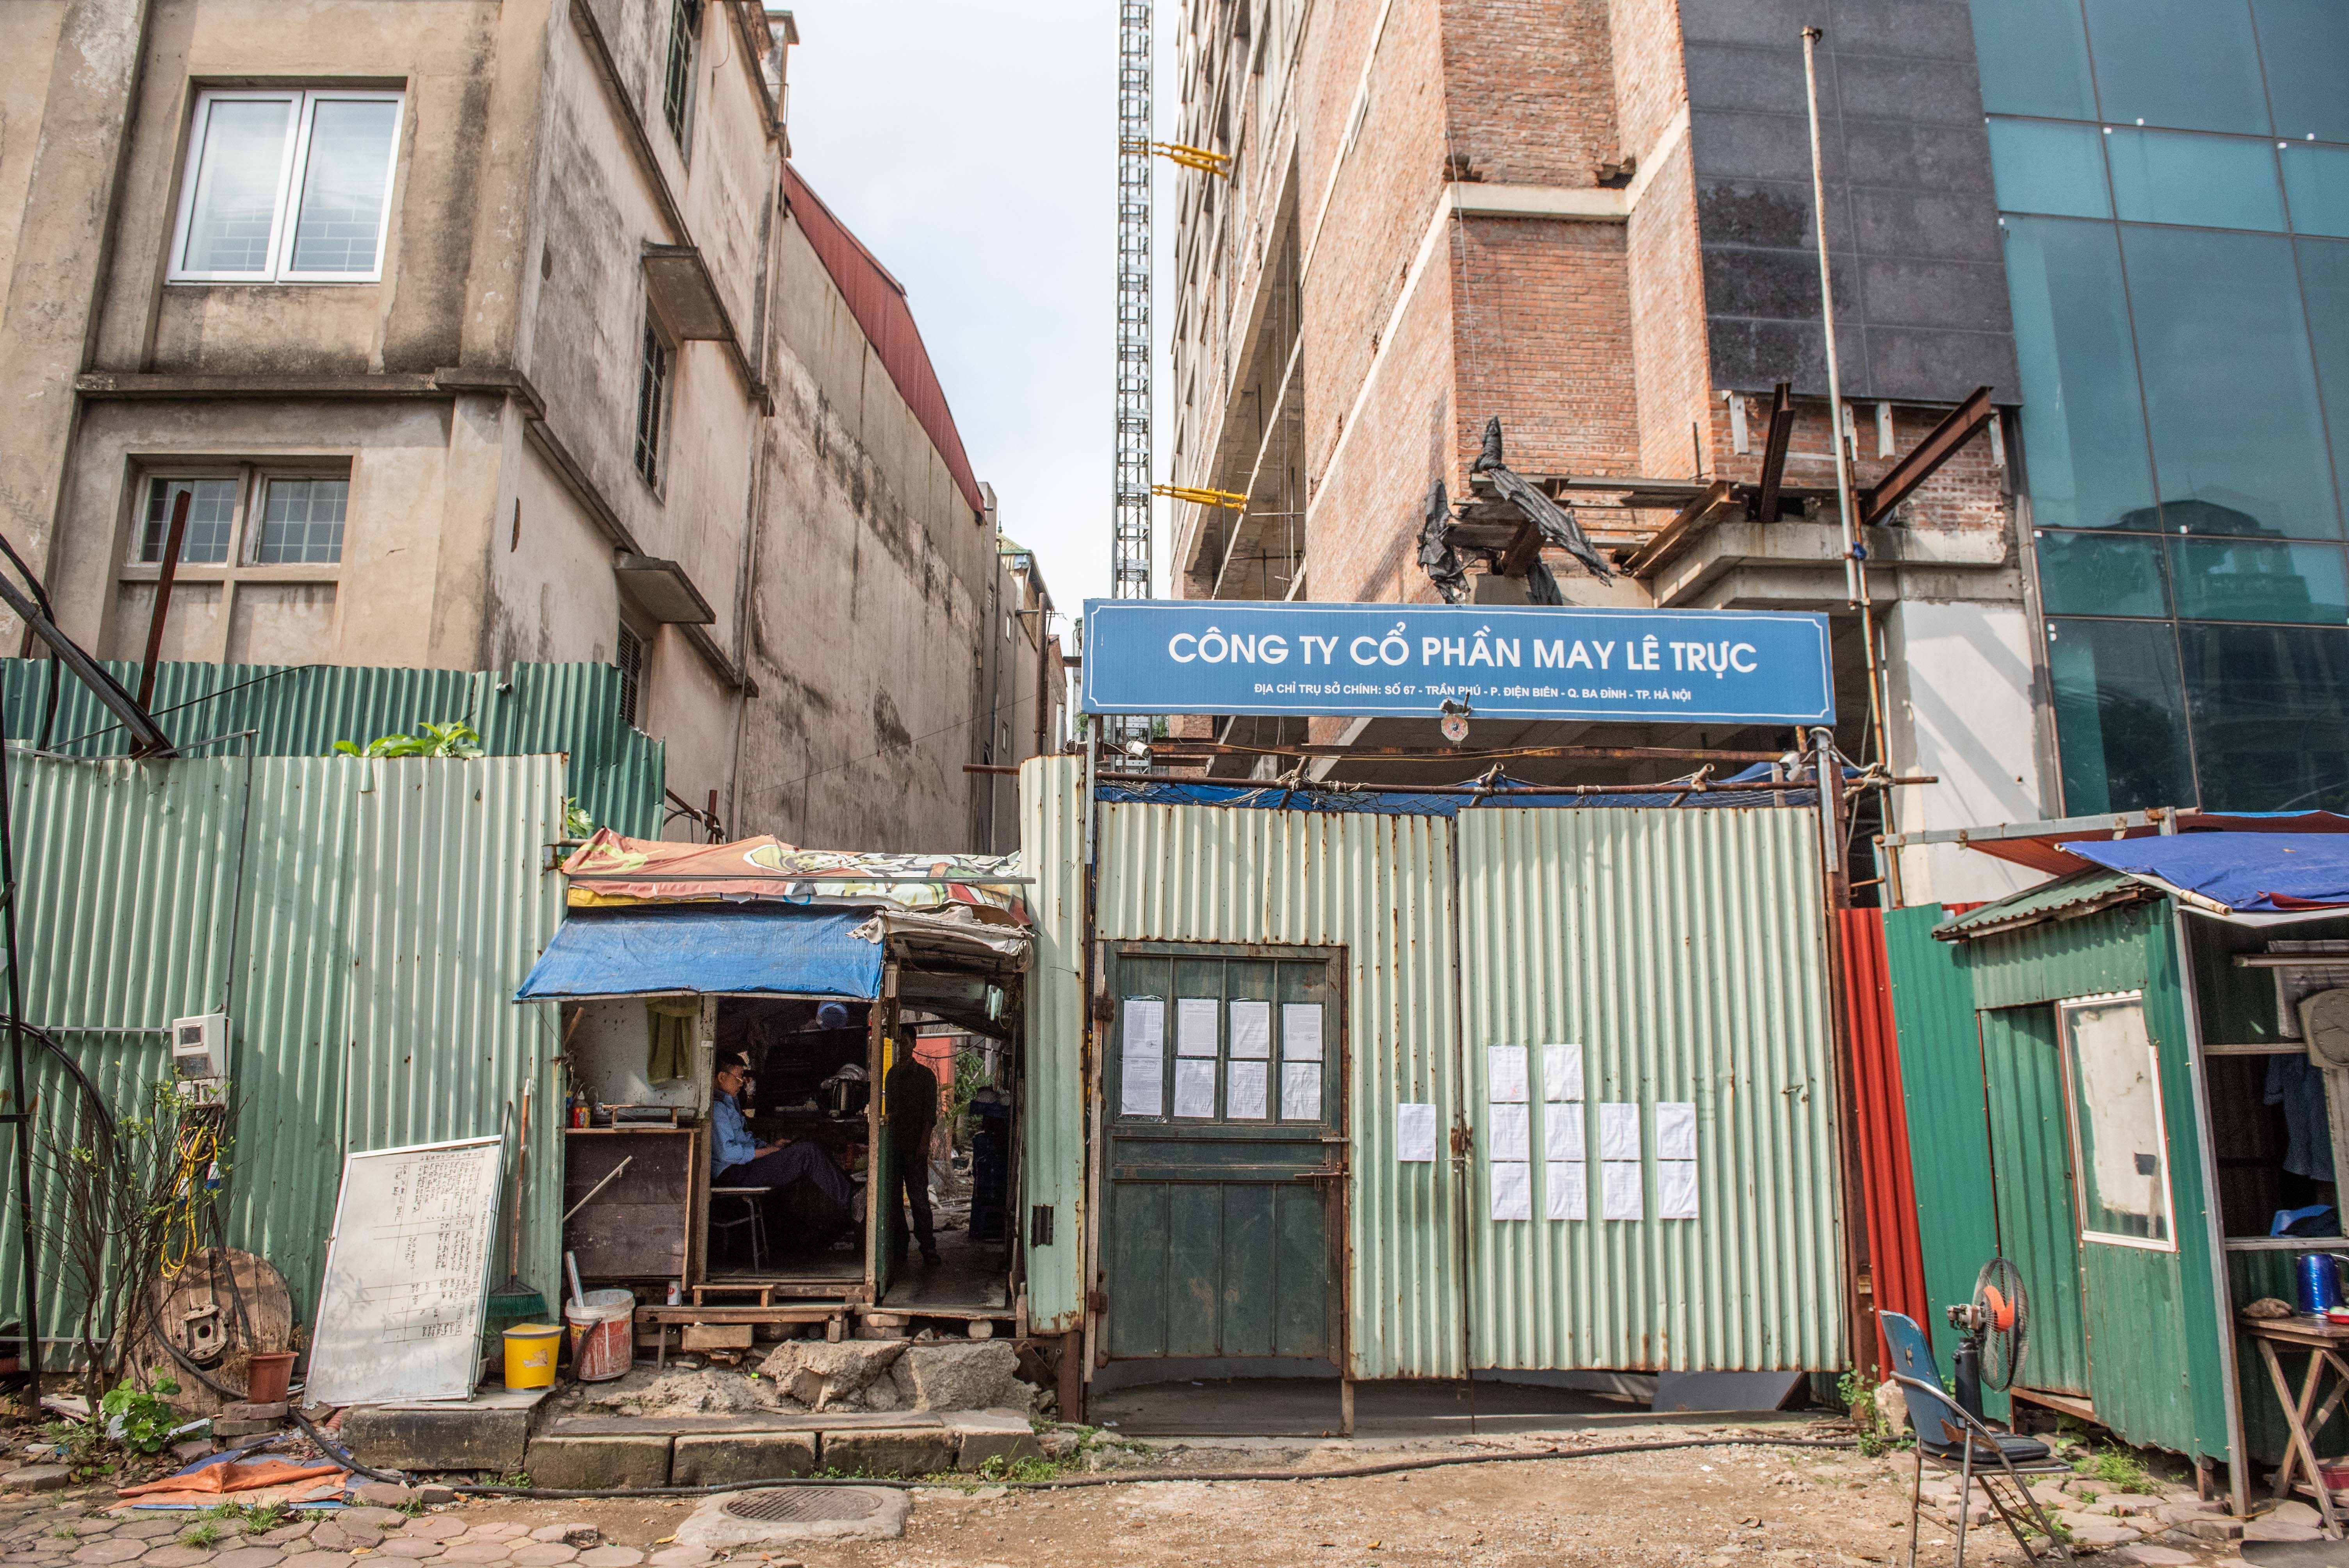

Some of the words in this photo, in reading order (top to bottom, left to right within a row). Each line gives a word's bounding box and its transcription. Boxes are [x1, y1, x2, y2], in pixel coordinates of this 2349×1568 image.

[1169, 626, 1289, 664] CÔNG
[1299, 636, 1339, 665] TY
[1350, 621, 1410, 666] CỔ
[1422, 625, 1521, 668] PHẦN
[1533, 639, 1615, 671] MAY
[1626, 634, 1659, 671] LÊ
[1670, 640, 1758, 679] TRỰC
[1255, 683, 1274, 696] ĐỊA
[1277, 681, 1296, 694] CHỈ
[1299, 684, 1321, 697] TRỤ
[1324, 681, 1340, 694] SỞ
[1344, 682, 1381, 695] CHÍNH:
[1385, 682, 1401, 695] SỐ
[1403, 685, 1416, 695] 67
[1426, 682, 1455, 695] TRẦN
[1458, 684, 1481, 696] PHÚ
[1491, 687, 1501, 696] P.
[1503, 686, 1529, 698] ĐIỆN
[1533, 686, 1558, 697] BIÊN
[1568, 688, 1579, 698] Q.
[1582, 689, 1598, 698] BA
[1600, 687, 1626, 699] ĐÌNH
[1636, 690, 1650, 699] TP.
[1654, 688, 1669, 700] HÀ
[1672, 689, 1691, 702] NỘI
